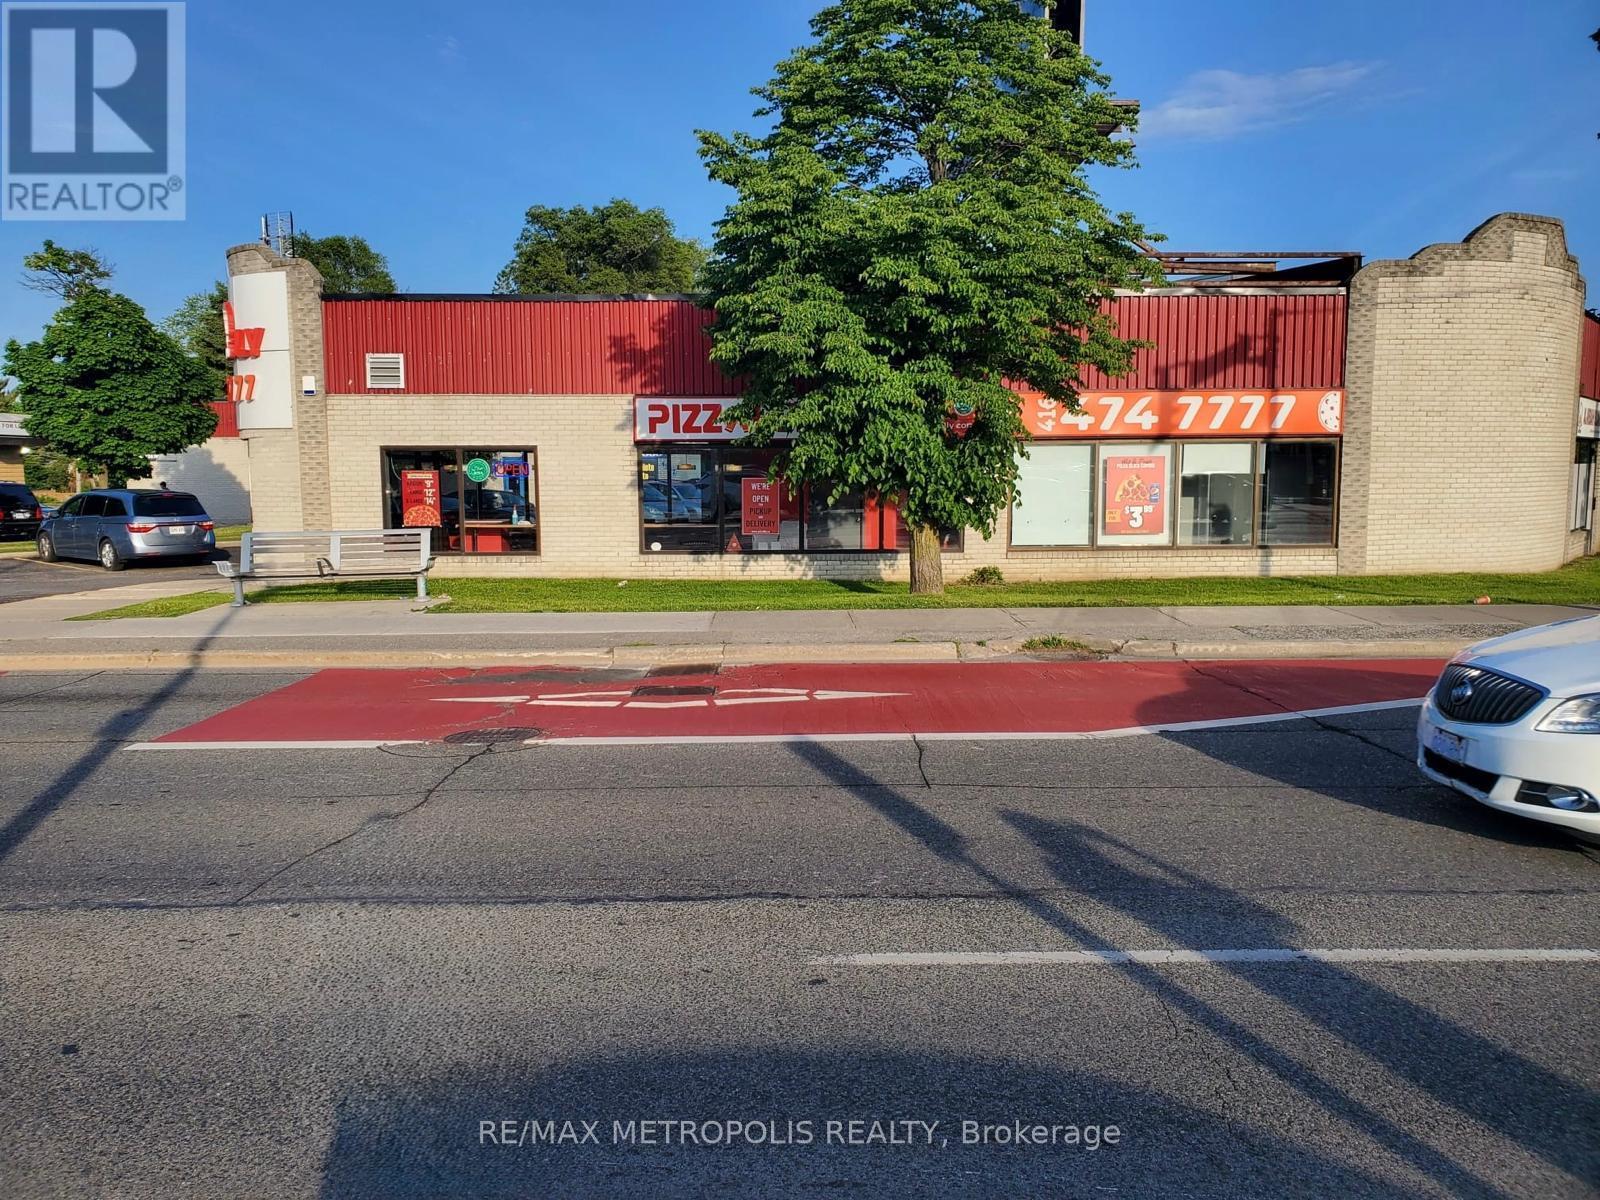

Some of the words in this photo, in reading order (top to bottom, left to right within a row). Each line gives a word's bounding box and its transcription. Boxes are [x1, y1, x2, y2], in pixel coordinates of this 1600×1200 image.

[1060, 396, 1160, 431] 474
[1176, 395, 1297, 430] 7777
[495, 462, 529, 475] OPEN
[751, 482, 770, 491] WE'RE
[752, 495, 769, 503] OPEN
[749, 507, 772, 515] PICKUP
[745, 520, 775, 528] DELIVERY
